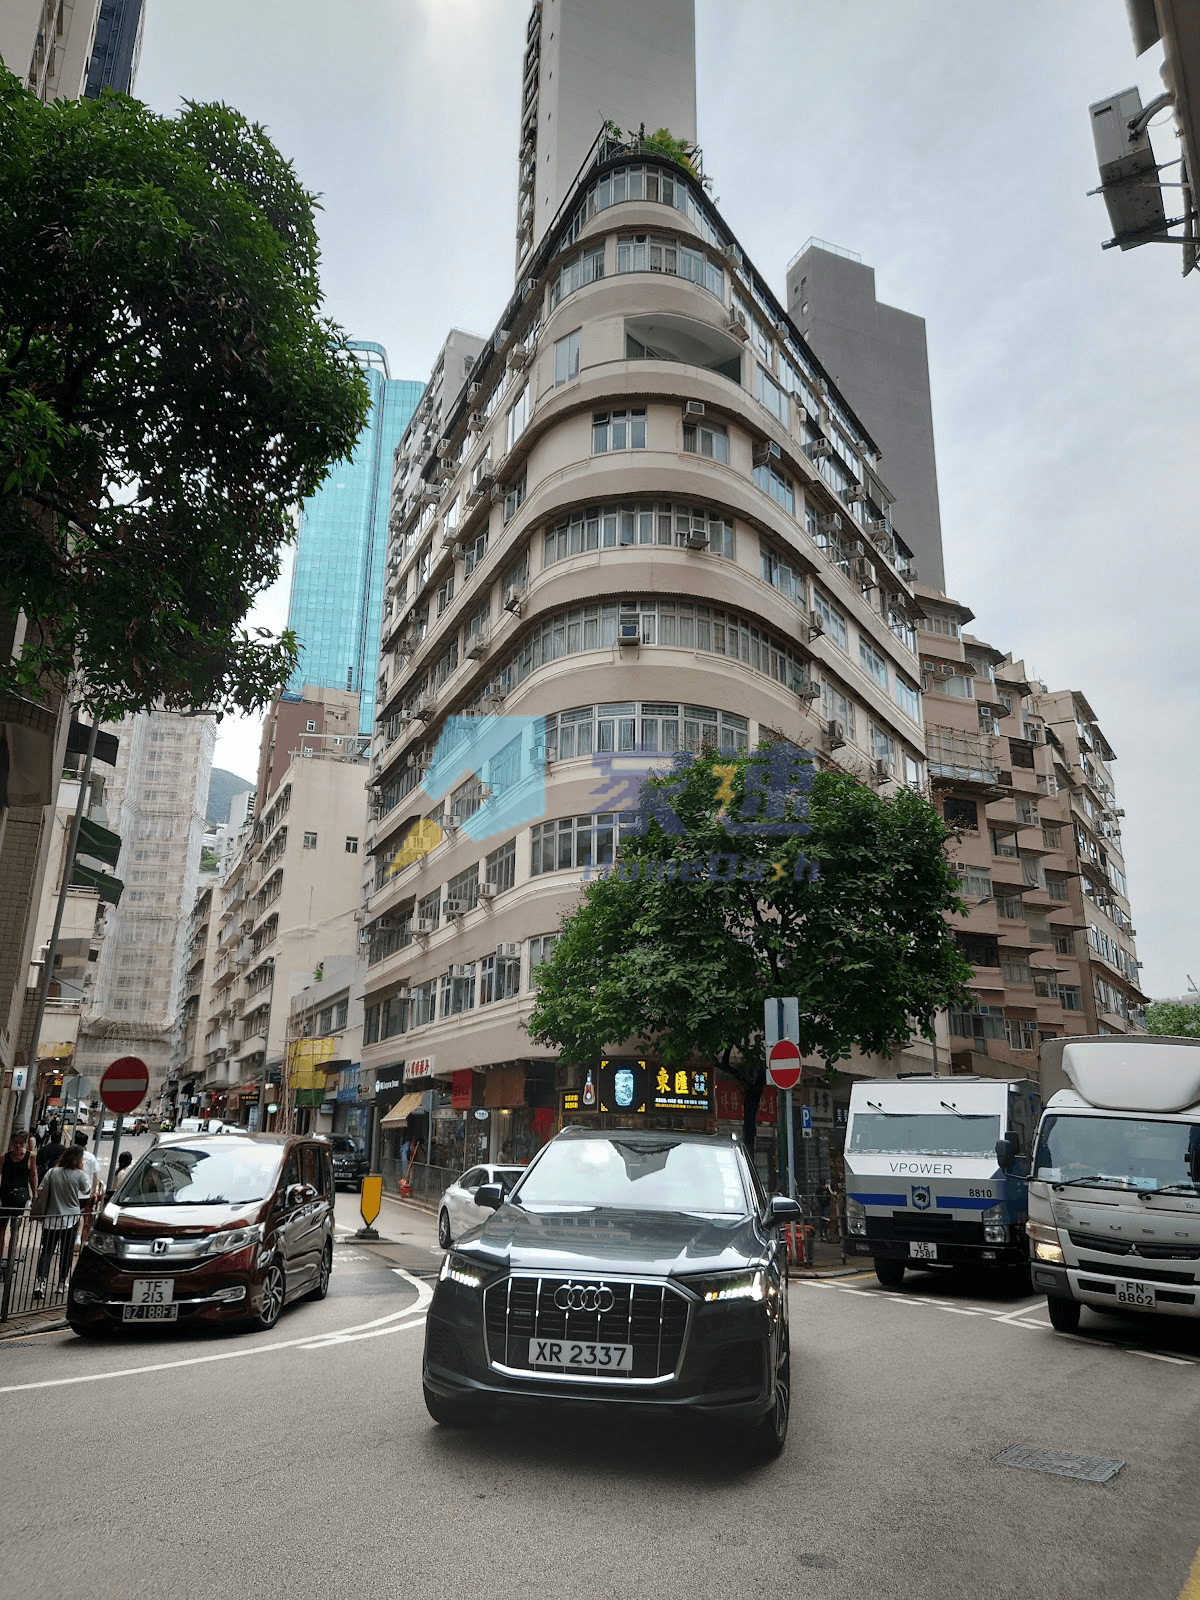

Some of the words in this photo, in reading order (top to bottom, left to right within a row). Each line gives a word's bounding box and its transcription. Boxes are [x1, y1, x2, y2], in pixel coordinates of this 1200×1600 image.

[889, 1162, 953, 1174] VPOWER
[968, 1188, 992, 1198] 8810
[1079, 1221, 1189, 1238] FUSO
[917, 1242, 929, 1251] VE
[146, 1281, 163, 1292] TF
[1126, 1282, 1145, 1294] FN
[141, 1292, 164, 1303] 213
[1118, 1291, 1154, 1305] 8862
[535, 1341, 562, 1364] XR
[569, 1344, 627, 1367] 2337
